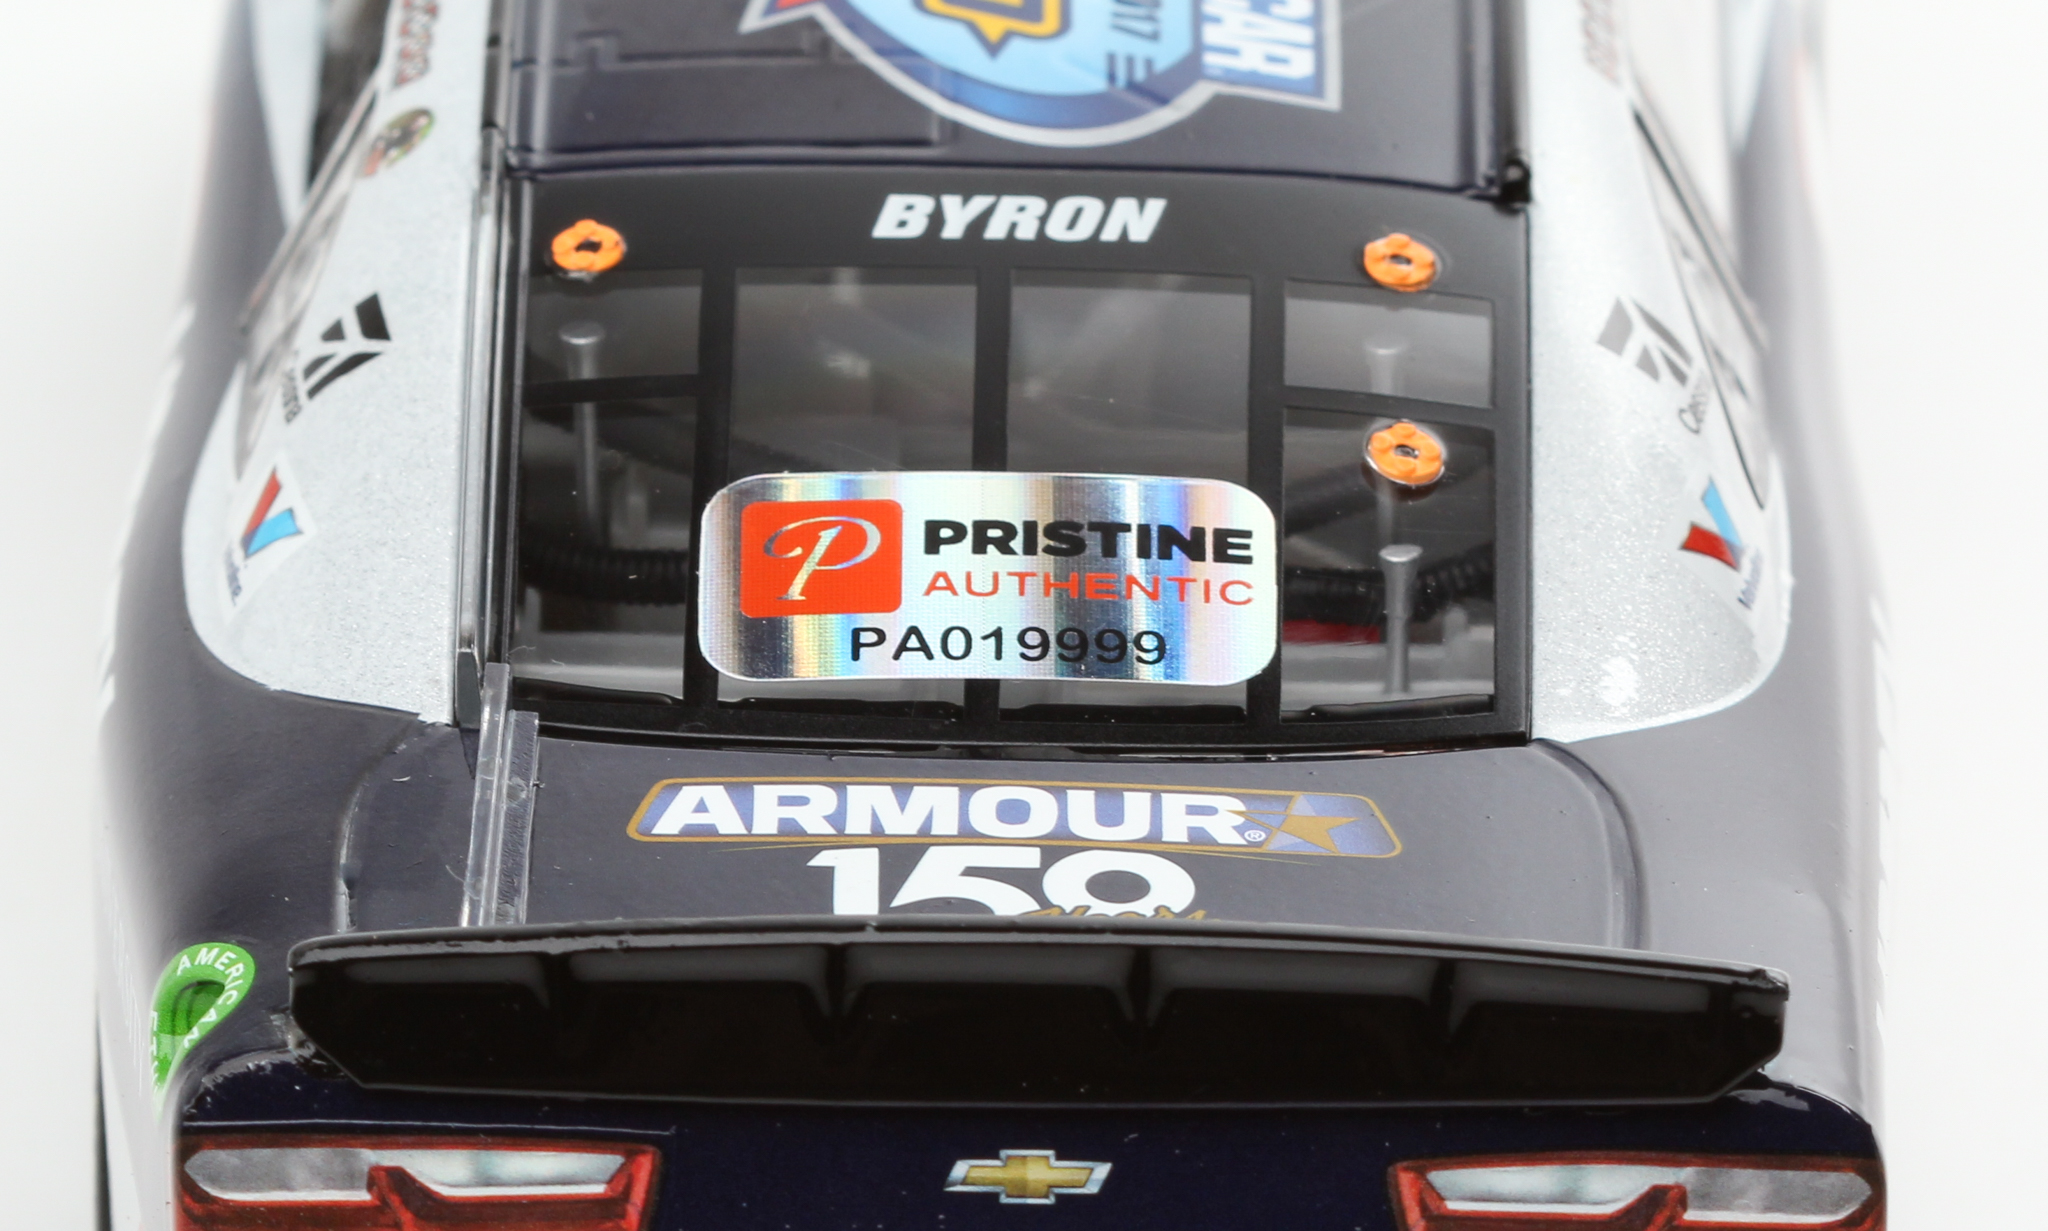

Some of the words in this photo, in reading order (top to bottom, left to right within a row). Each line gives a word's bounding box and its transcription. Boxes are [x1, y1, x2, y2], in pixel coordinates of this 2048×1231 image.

[871, 193, 1167, 242] BYRON
[924, 519, 1253, 564] PRISTINE
[923, 571, 1254, 605] AUTHENTIC
[851, 626, 1166, 664] PA019999
[176, 947, 244, 1049] AMERICAN
